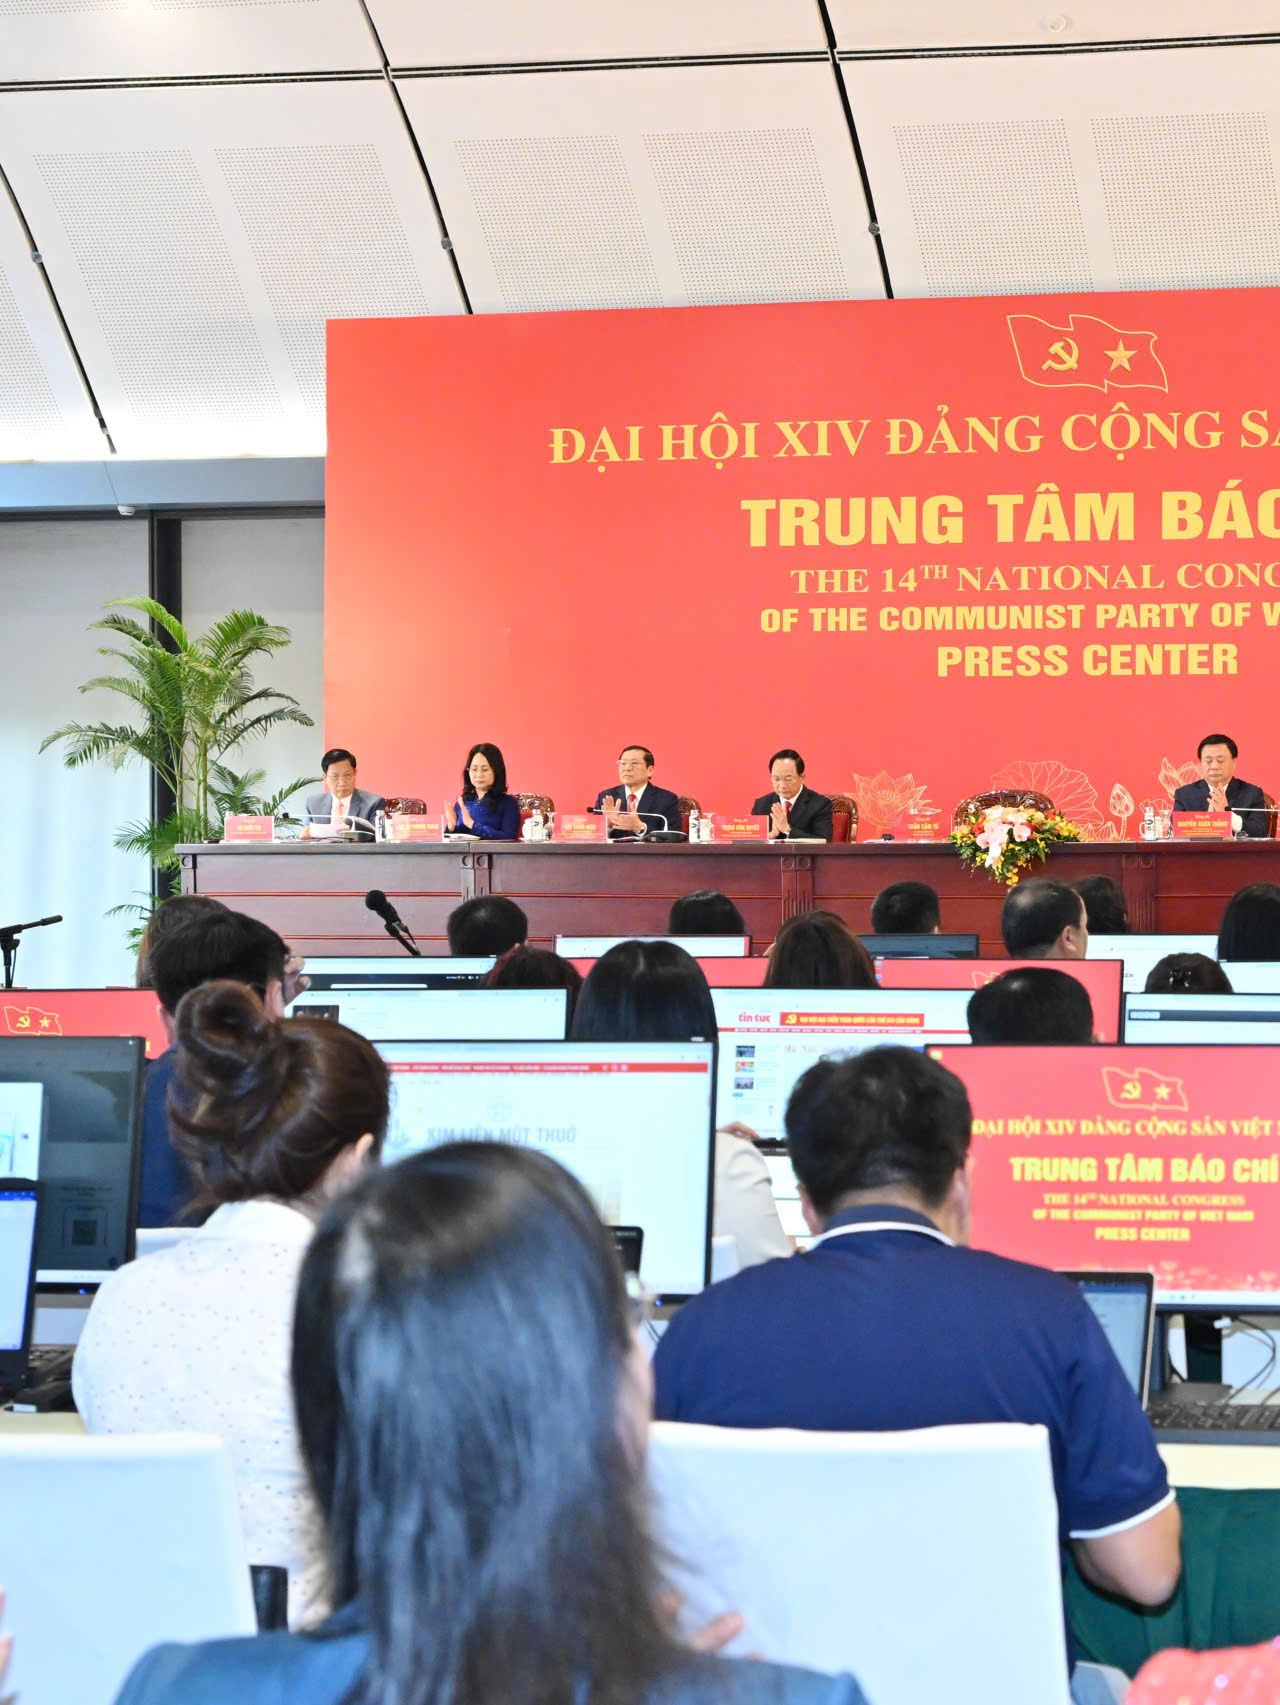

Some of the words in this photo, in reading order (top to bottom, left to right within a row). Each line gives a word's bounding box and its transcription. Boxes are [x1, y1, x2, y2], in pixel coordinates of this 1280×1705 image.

[549, 426, 643, 472] ĐẠI
[659, 412, 760, 469] HỘI
[774, 420, 871, 457] XIV
[886, 405, 1044, 454] ĐẢNG
[1062, 402, 1224, 460] CỘNG
[741, 495, 963, 547] TRUNG
[987, 483, 1134, 542] TÂM
[790, 569, 869, 593] THE
[882, 565, 948, 592] 14TH
[957, 564, 1164, 591] NATIONAL
[761, 608, 799, 632] OF
[809, 608, 867, 632] THE
[880, 604, 1085, 631] COMMUNIST
[1096, 603, 1199, 628] PARTY
[1211, 602, 1251, 627] OF
[938, 645, 1068, 677] PRESS
[1083, 643, 1238, 676] CENTER
[1008, 1115, 1041, 1139] HỘI
[1045, 1119, 1076, 1135] XIV
[1135, 1116, 1187, 1139] CỘNG
[1230, 1116, 1274, 1139] VIỆT
[1009, 1157, 1098, 1181] TRUNG
[1104, 1152, 1163, 1182] TÂM
[1170, 1153, 1226, 1182] BÁO
[1233, 1153, 1279, 1182] CHÍ
[1043, 1193, 1070, 1205] THE
[1099, 1193, 1169, 1206] NATIONAL
[1095, 1227, 1138, 1240] PRESS
[1140, 1228, 1190, 1241] CENTER
